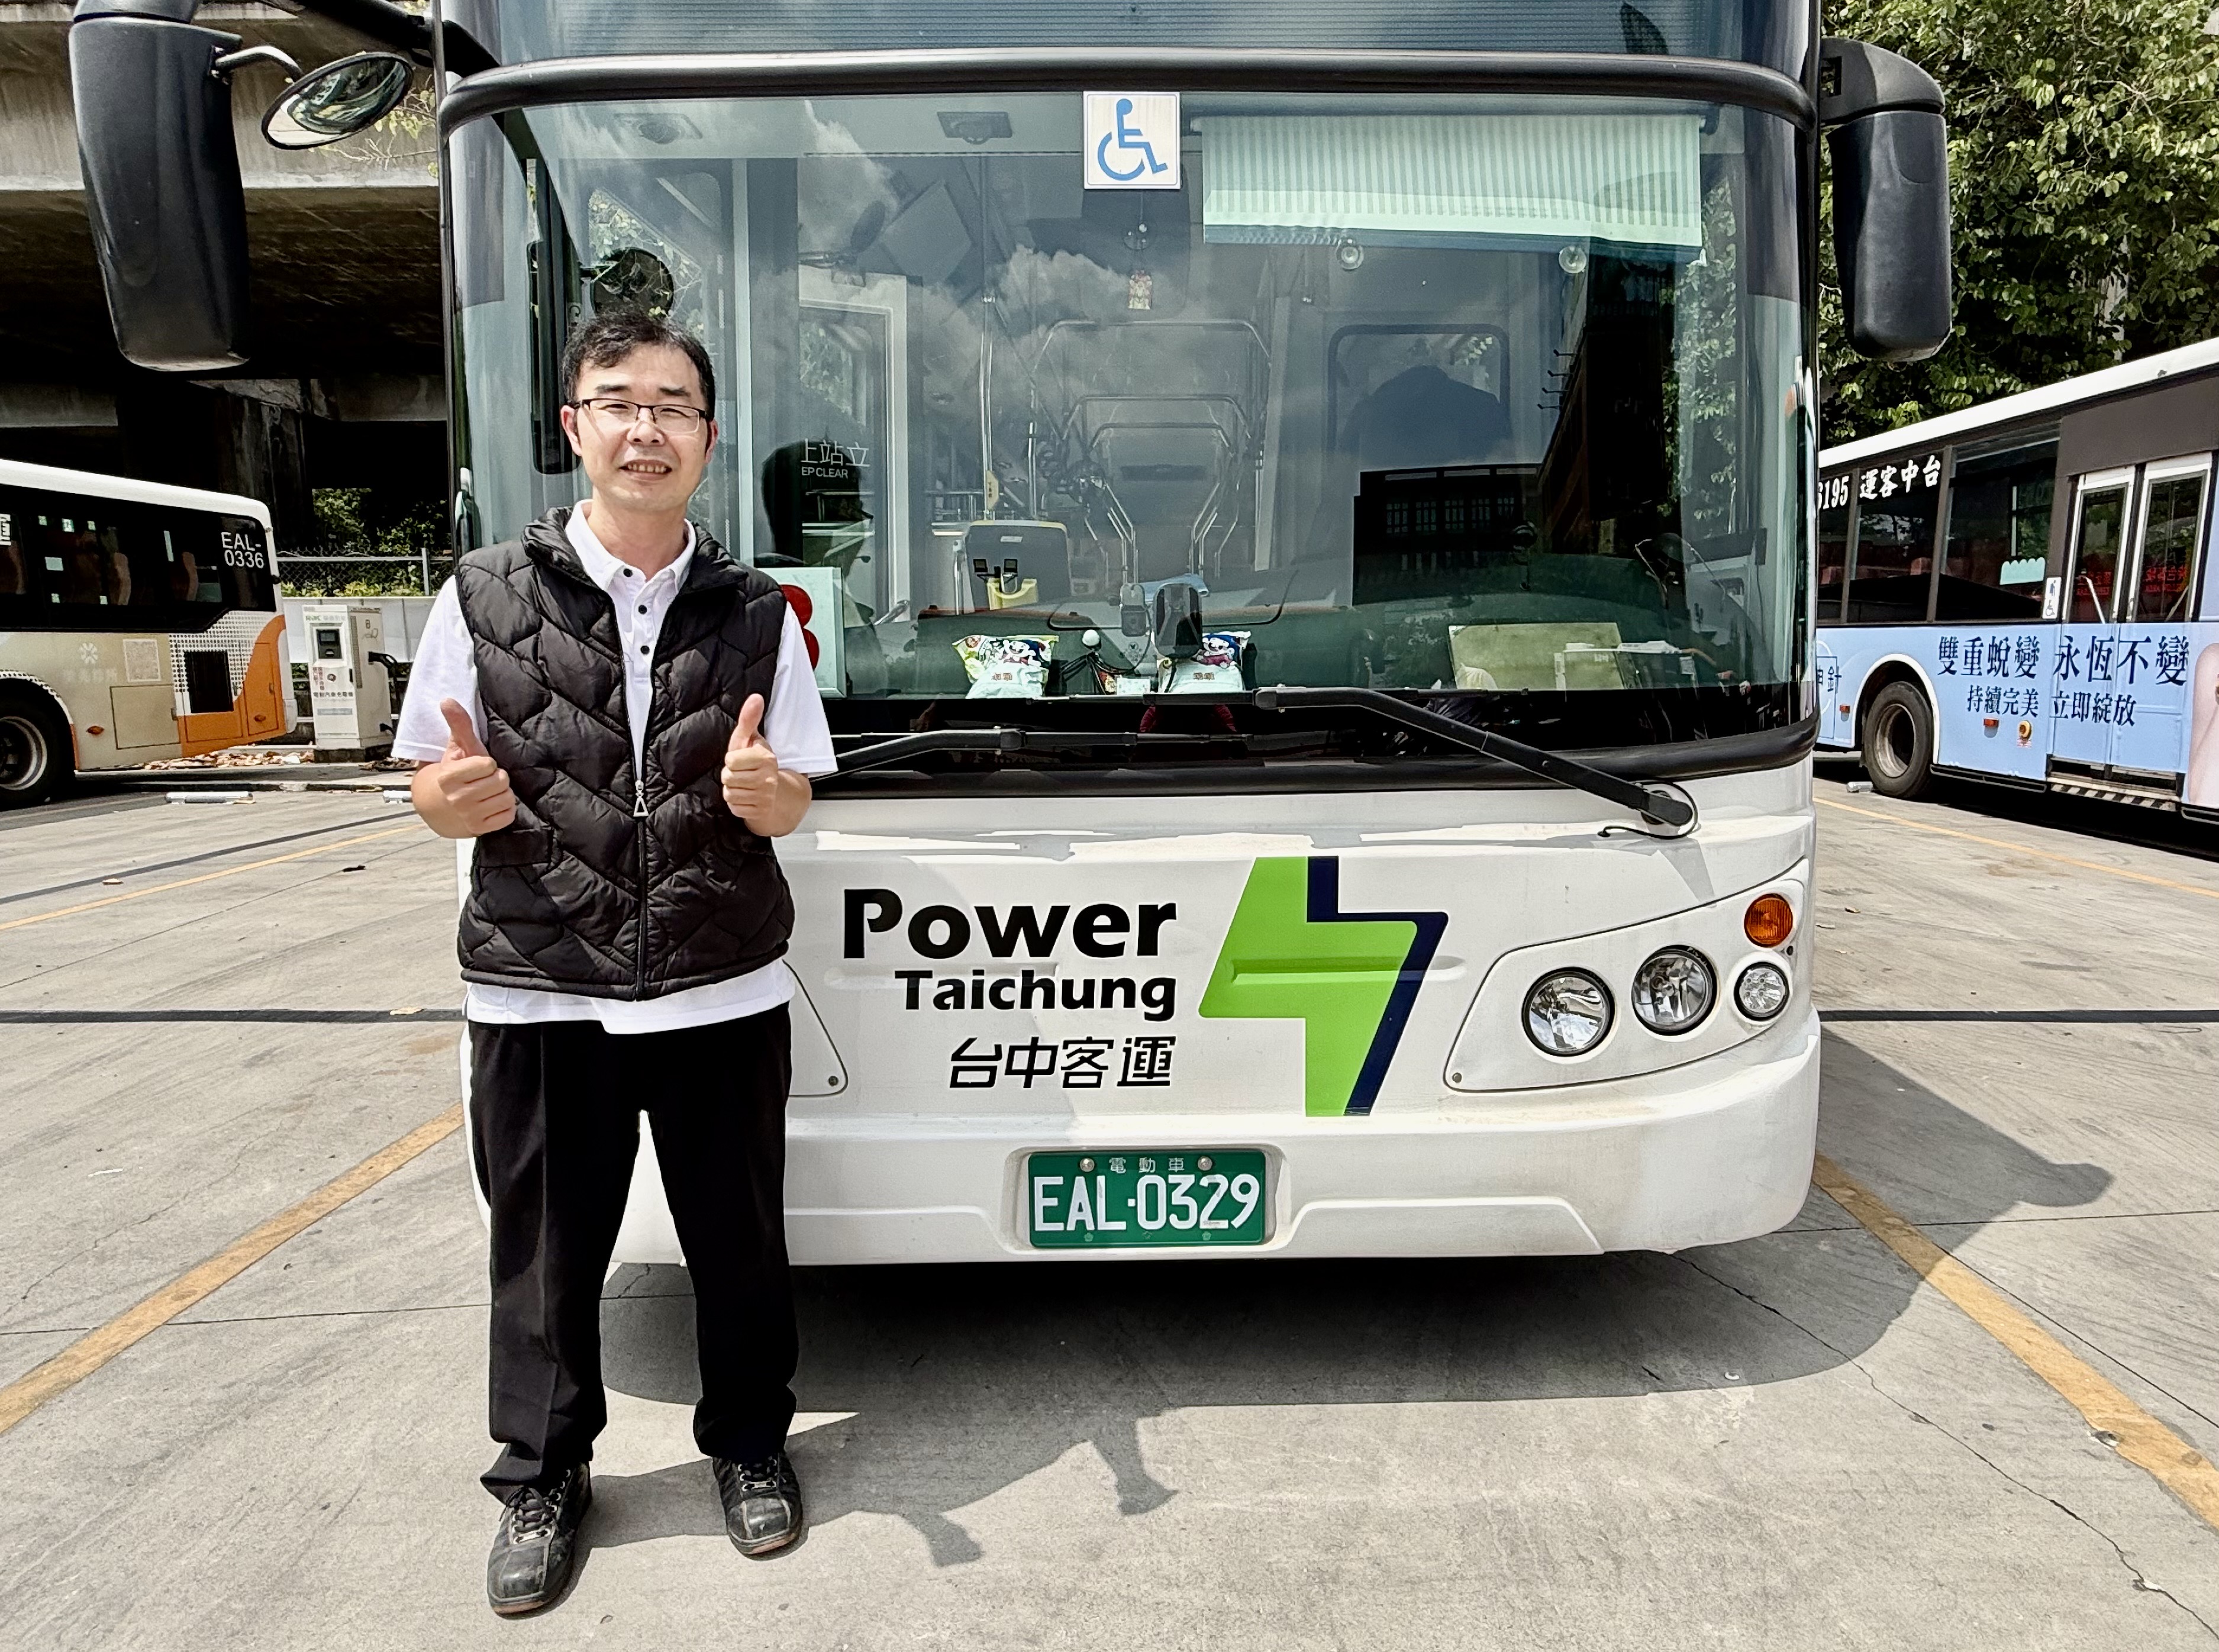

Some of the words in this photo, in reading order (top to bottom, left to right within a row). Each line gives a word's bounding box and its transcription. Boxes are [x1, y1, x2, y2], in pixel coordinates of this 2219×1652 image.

[815, 467, 849, 479] CLEAR
[221, 531, 261, 551] EAL-
[224, 549, 265, 569] 0336
[1937, 635, 2040, 679] 雙重蛻變
[2053, 635, 2189, 686] 永恆不變
[1967, 684, 2039, 718] 持續完美
[2049, 690, 2137, 727] 立即綻放
[843, 889, 1177, 959] Power
[895, 969, 1176, 1021] Taichung
[949, 1036, 1176, 1088] 台中客運
[1109, 1157, 1185, 1174] 電動車
